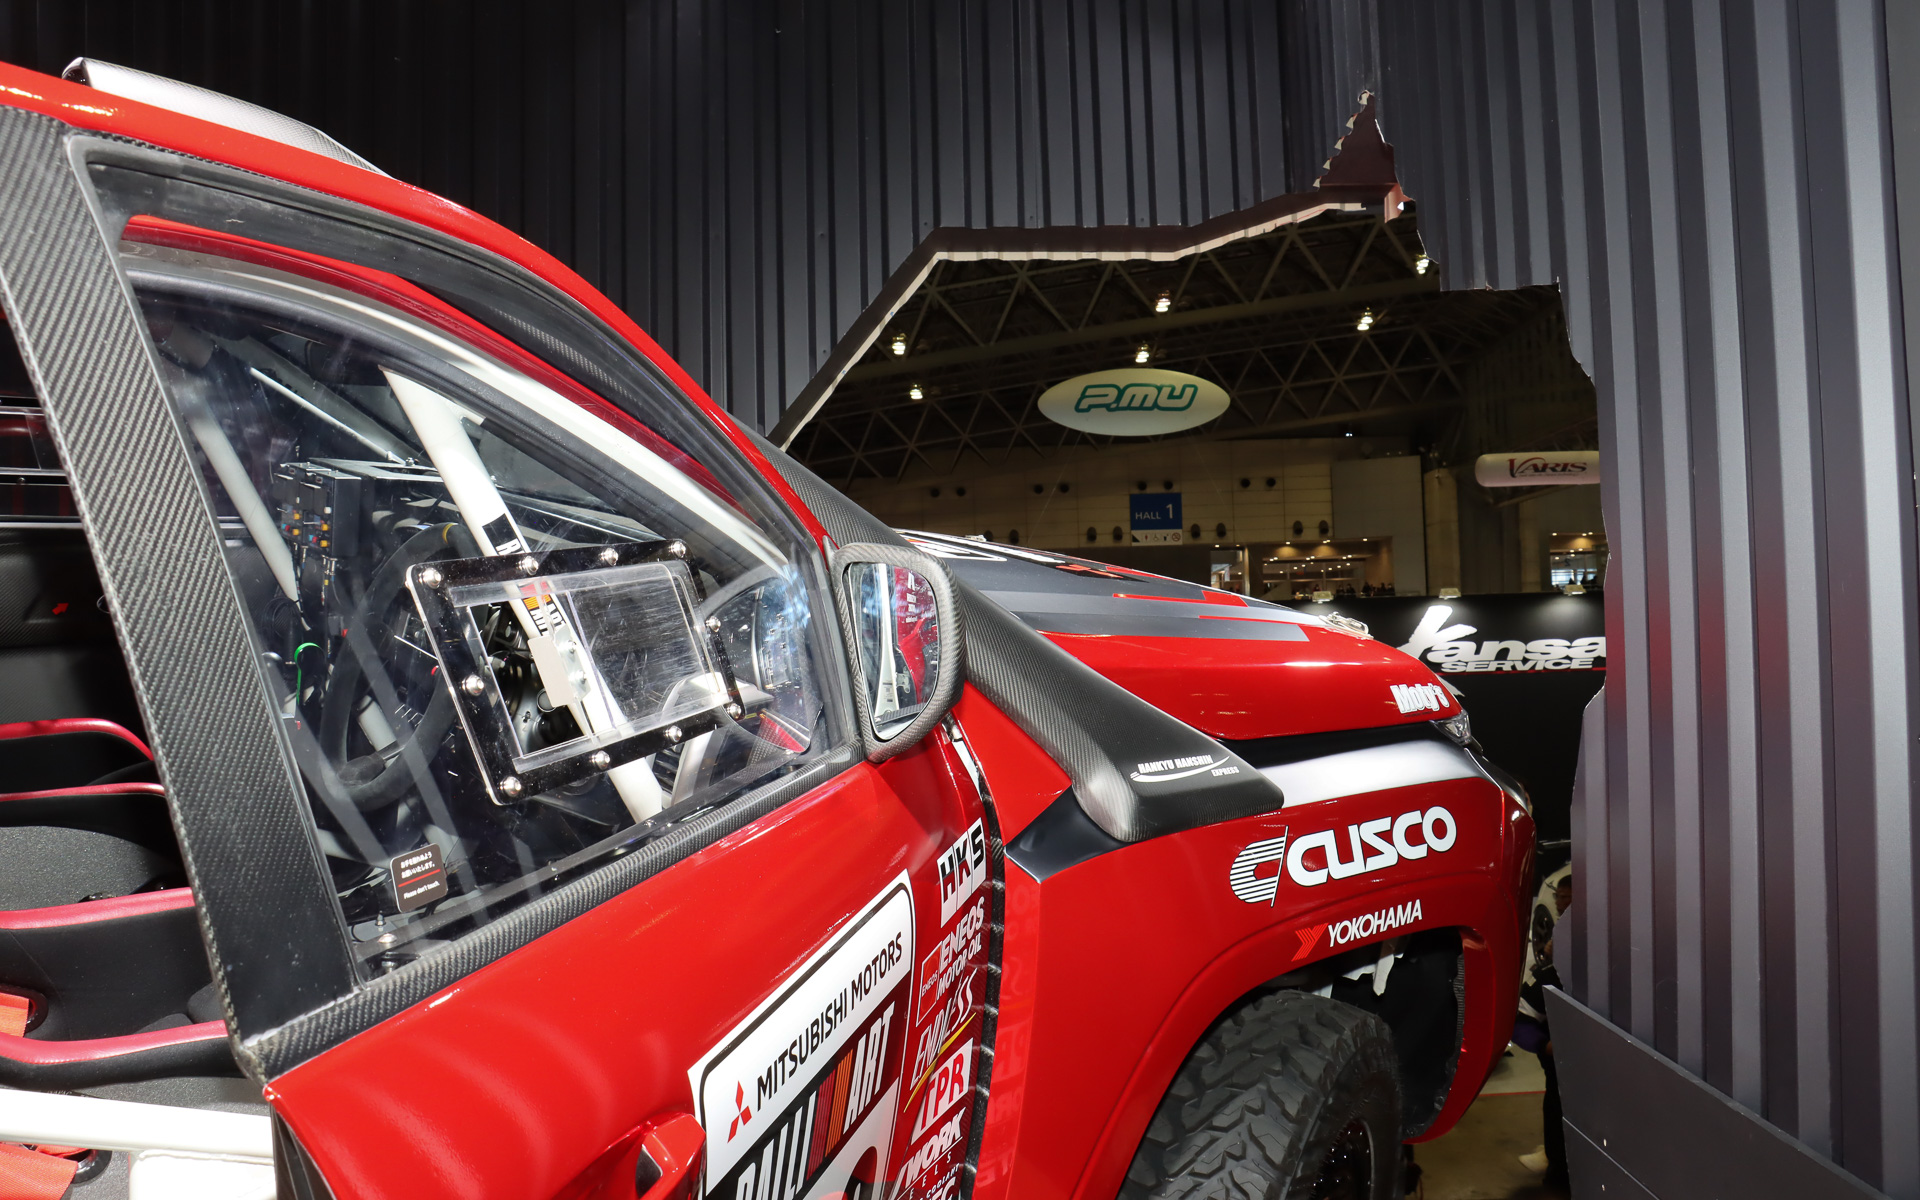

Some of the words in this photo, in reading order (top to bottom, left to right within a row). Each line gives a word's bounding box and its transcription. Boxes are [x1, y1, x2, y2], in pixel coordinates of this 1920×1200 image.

[1508, 457, 1588, 478] VARIS
[1135, 511, 1161, 520] HALL
[1166, 503, 1174, 519] 1
[1390, 683, 1450, 714] Moty's
[1441, 658, 1594, 673] SERVICE
[1138, 759, 1174, 774] HANKYU
[1174, 755, 1213, 769] HANSHIN
[1210, 766, 1239, 777] EXPRESS
[940, 824, 984, 904] HKS
[1286, 806, 1457, 887] CUSCO
[939, 896, 985, 974] ENEOS
[1328, 899, 1423, 947] YOKOHAMA
[937, 948, 968, 1001] MOTOR
[967, 932, 982, 961] OIL
[757, 988, 847, 1112] MITSUBISHI
[852, 932, 903, 1011] MOTORS
[910, 967, 978, 1090] ENDLESS
[920, 1053, 964, 1131] TPR
[888, 1107, 967, 1200] WORK
